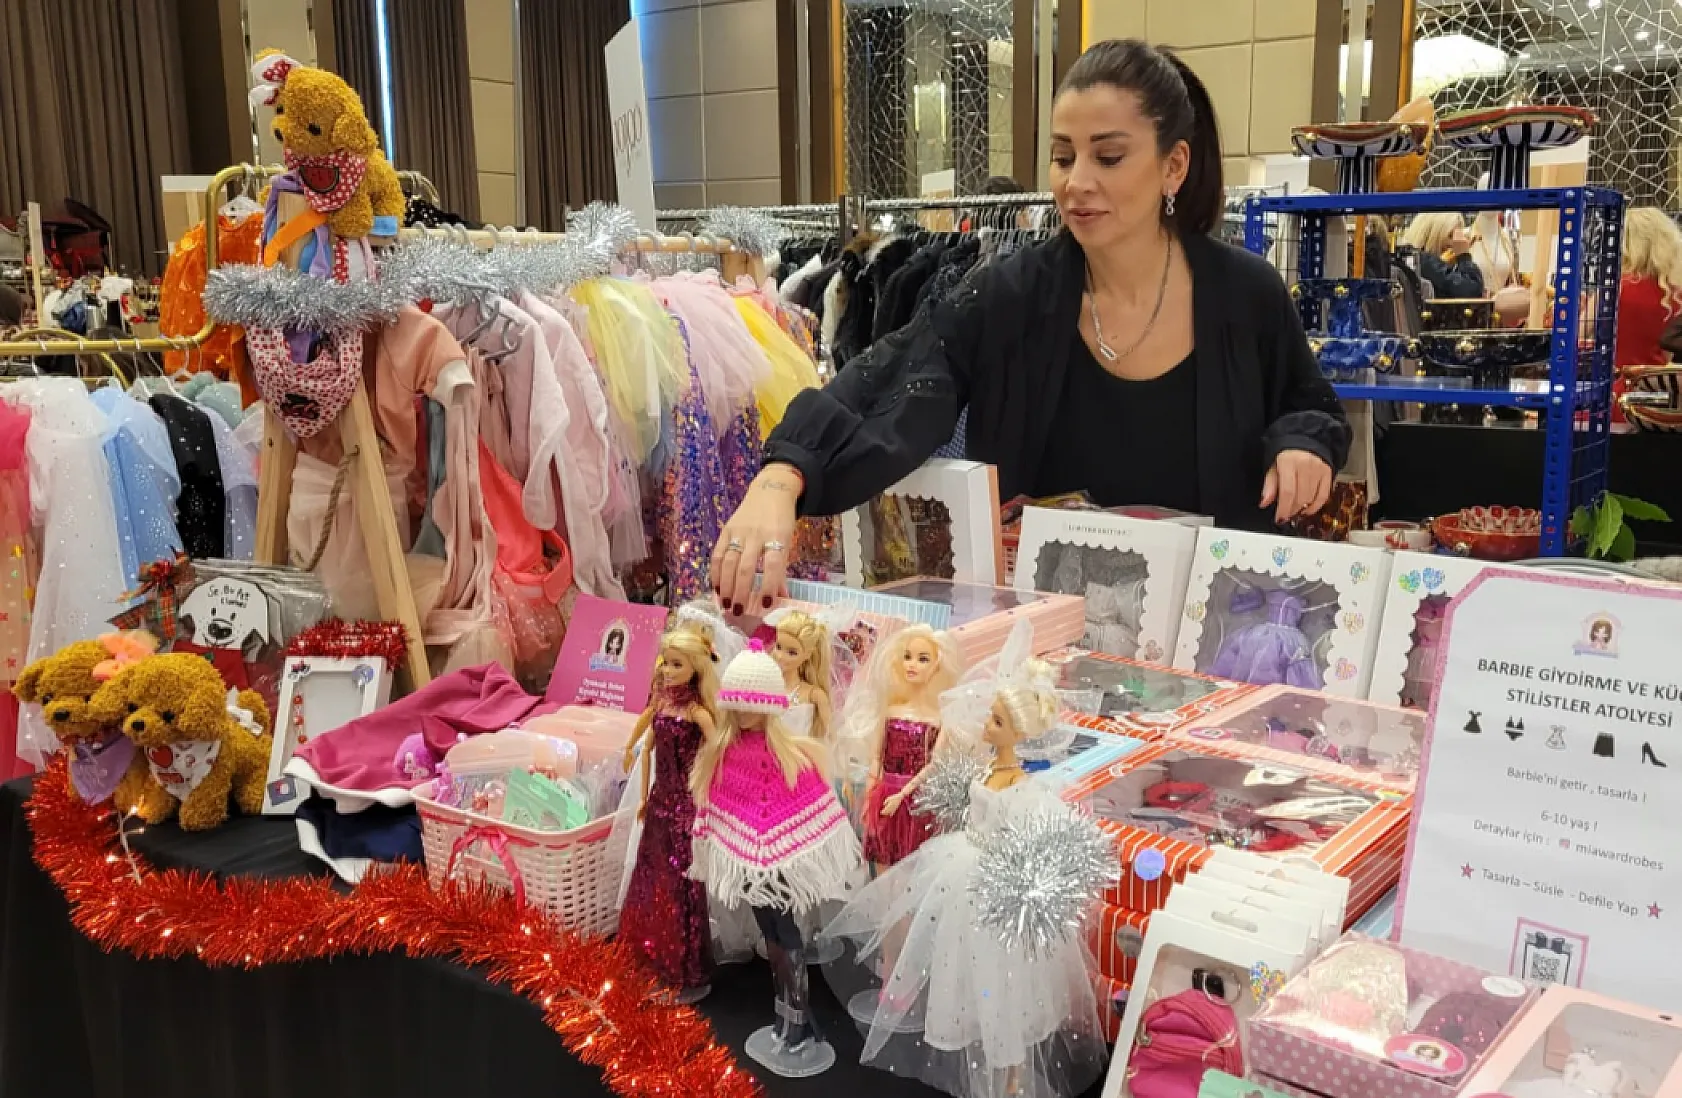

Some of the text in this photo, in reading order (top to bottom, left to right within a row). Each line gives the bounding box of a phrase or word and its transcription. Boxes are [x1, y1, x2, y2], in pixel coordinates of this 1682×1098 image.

[1477, 658, 1535, 680] BARBIE
[1538, 665, 1622, 693] GİYDİRME
[1627, 680, 1649, 697] VE
[1506, 688, 1674, 728] STİLİSTLER ATOLYESİ
[1506, 765, 1558, 787] Barbie'ni
[1559, 778, 1588, 791] getir
[1597, 784, 1638, 803] tasarla
[1540, 809, 1567, 826] 6-10
[1570, 817, 1590, 833] yaş
[1473, 818, 1520, 840] Detaylar
[1523, 829, 1544, 846] için
[1575, 841, 1664, 871] miawardrobes
[1481, 867, 1520, 888] Tasarla
[1533, 880, 1565, 899] Süsle
[1578, 890, 1614, 910] Defile
[1617, 900, 1639, 917] Yap
